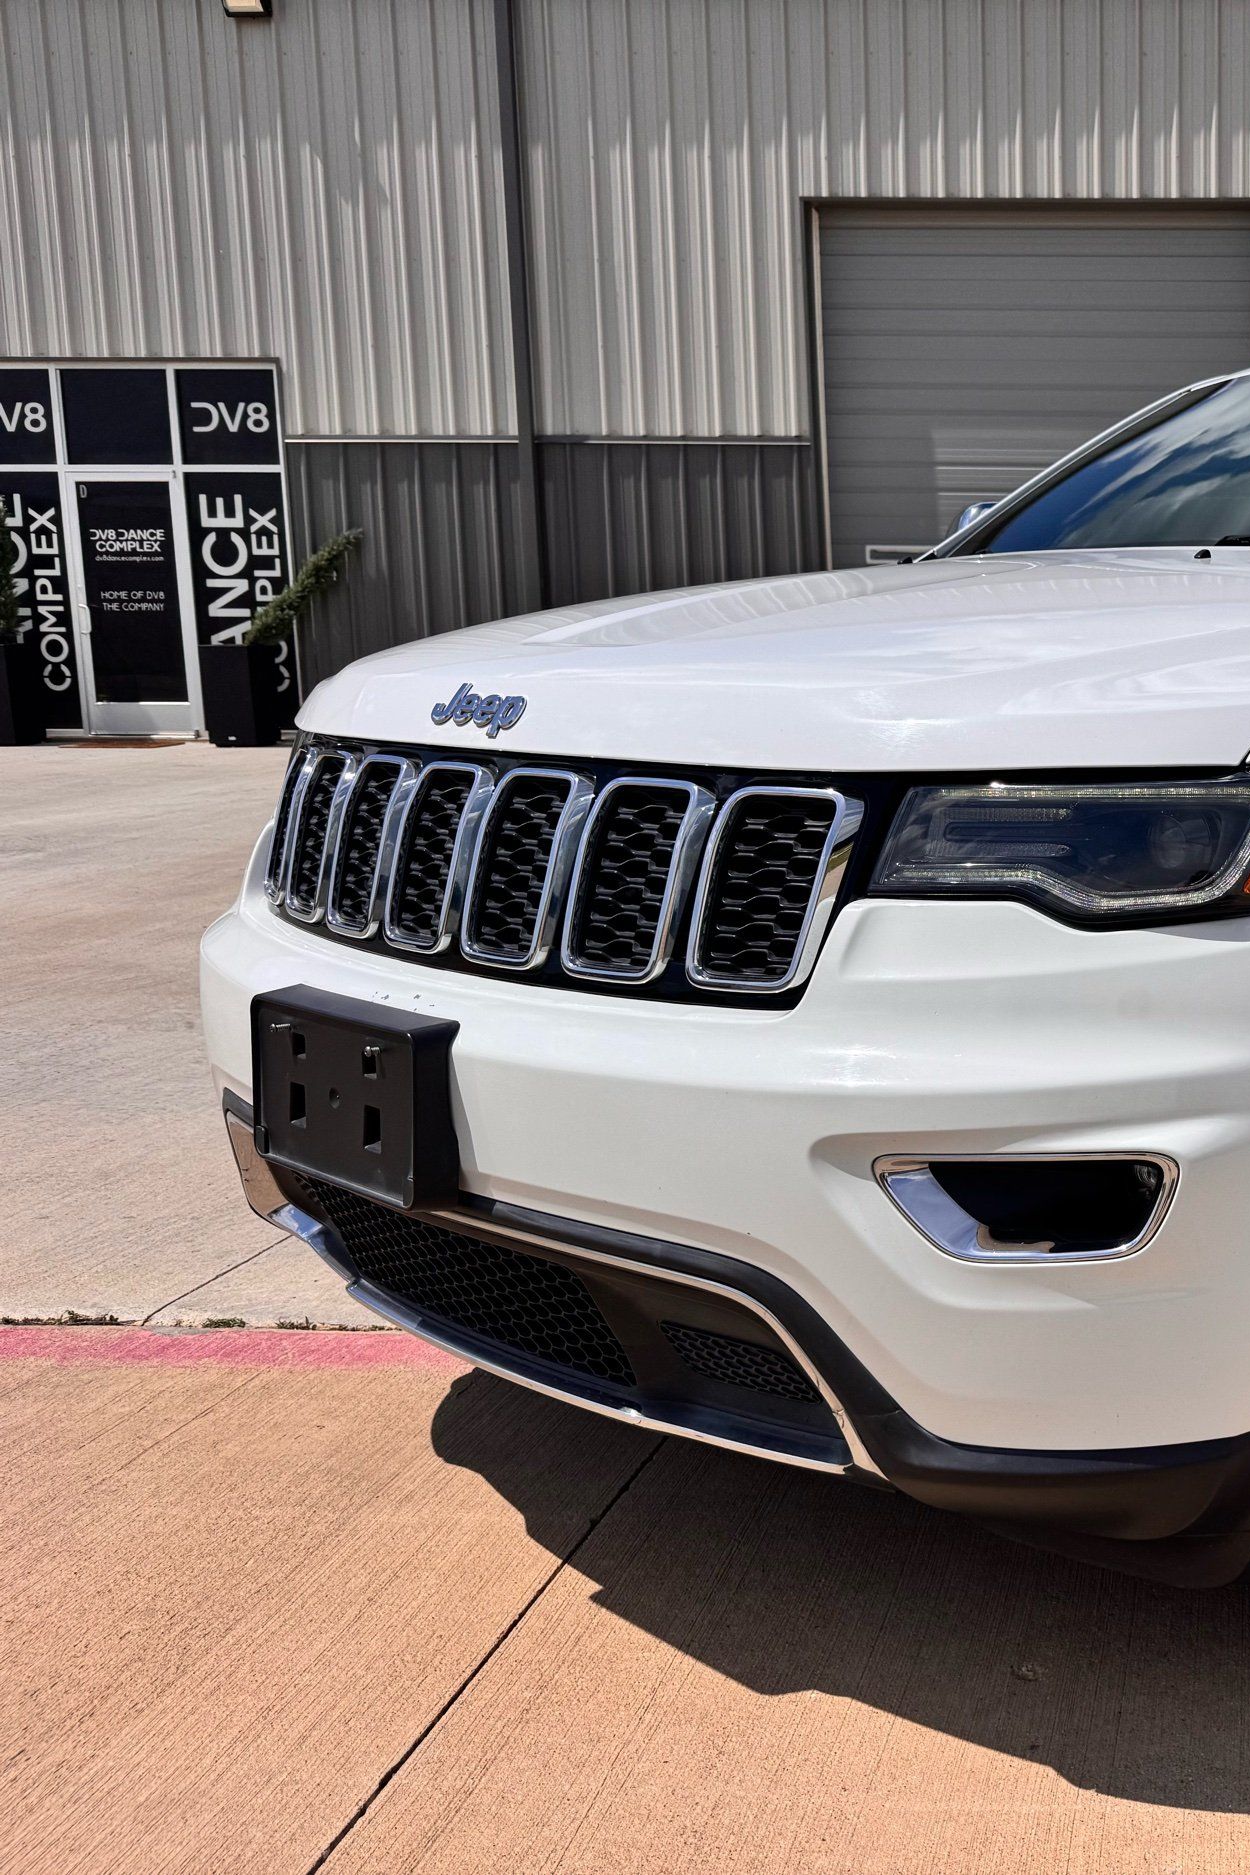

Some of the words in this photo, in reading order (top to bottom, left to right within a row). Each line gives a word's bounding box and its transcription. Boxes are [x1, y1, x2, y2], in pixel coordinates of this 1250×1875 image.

[0, 402, 46, 433] V8
[191, 402, 271, 433] DV8
[90, 529, 116, 540] DV8
[117, 529, 166, 540] DANCE
[96, 541, 161, 552] COMPLEX
[95, 555, 164, 563] dv8dancecomplex.com
[198, 494, 253, 645] ANCE
[27, 506, 72, 692] COMPLEX
[101, 591, 129, 600] HOME
[131, 591, 144, 599] OF
[146, 591, 165, 600] DV8
[102, 602, 120, 611] THE
[122, 602, 164, 611] COMPANY
[431, 683, 528, 739] Jeep
